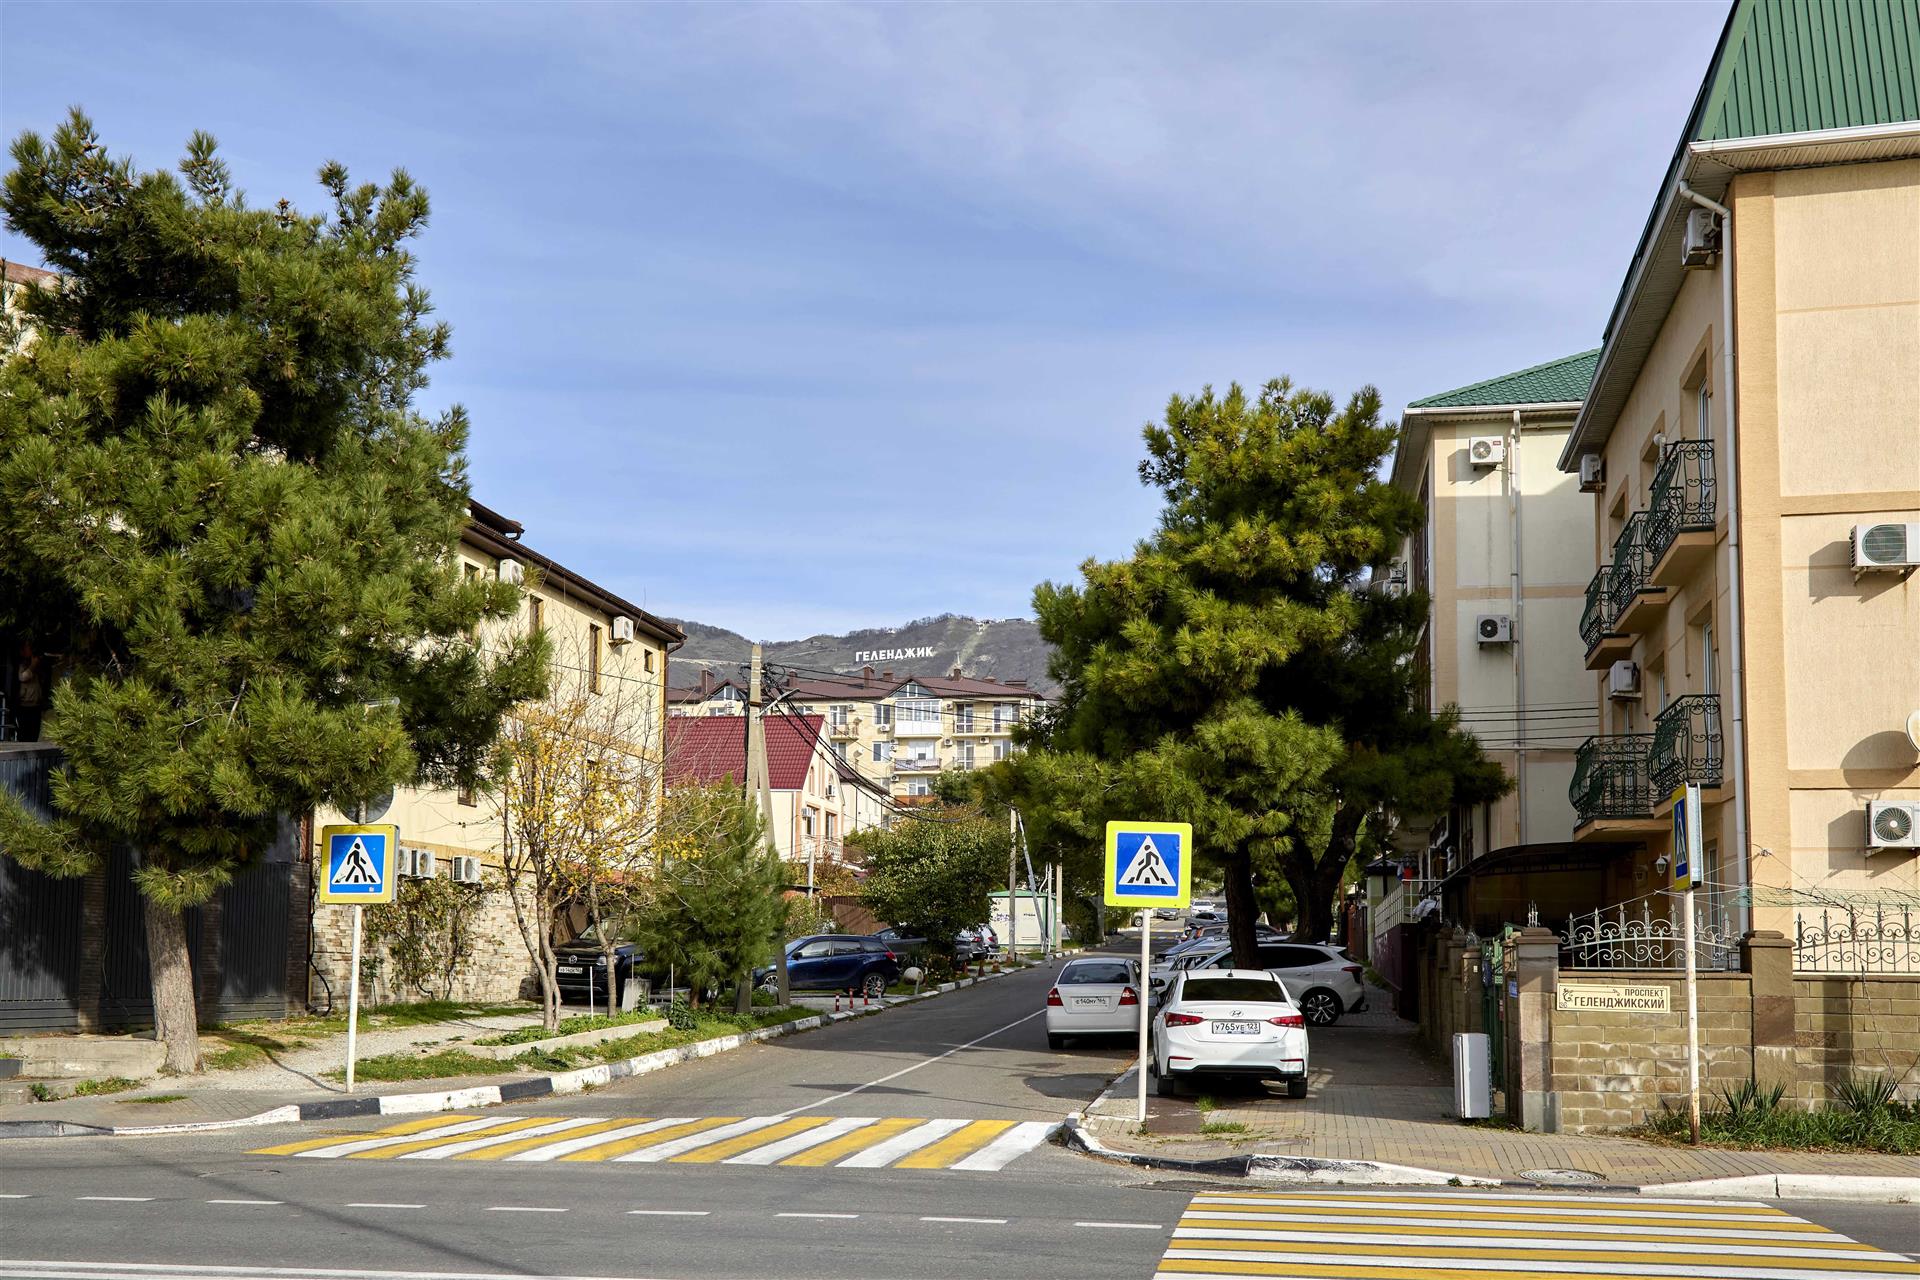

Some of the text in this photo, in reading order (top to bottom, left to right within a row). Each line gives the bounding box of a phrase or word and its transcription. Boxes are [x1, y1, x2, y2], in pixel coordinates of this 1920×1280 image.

[855, 646, 934, 662] ГЕЛЕНДЖИК
[1624, 988, 1664, 997] ПРОСПЕКТ
[1574, 996, 1665, 1009] ГЕЛЕНДЖИКСКИЙ
